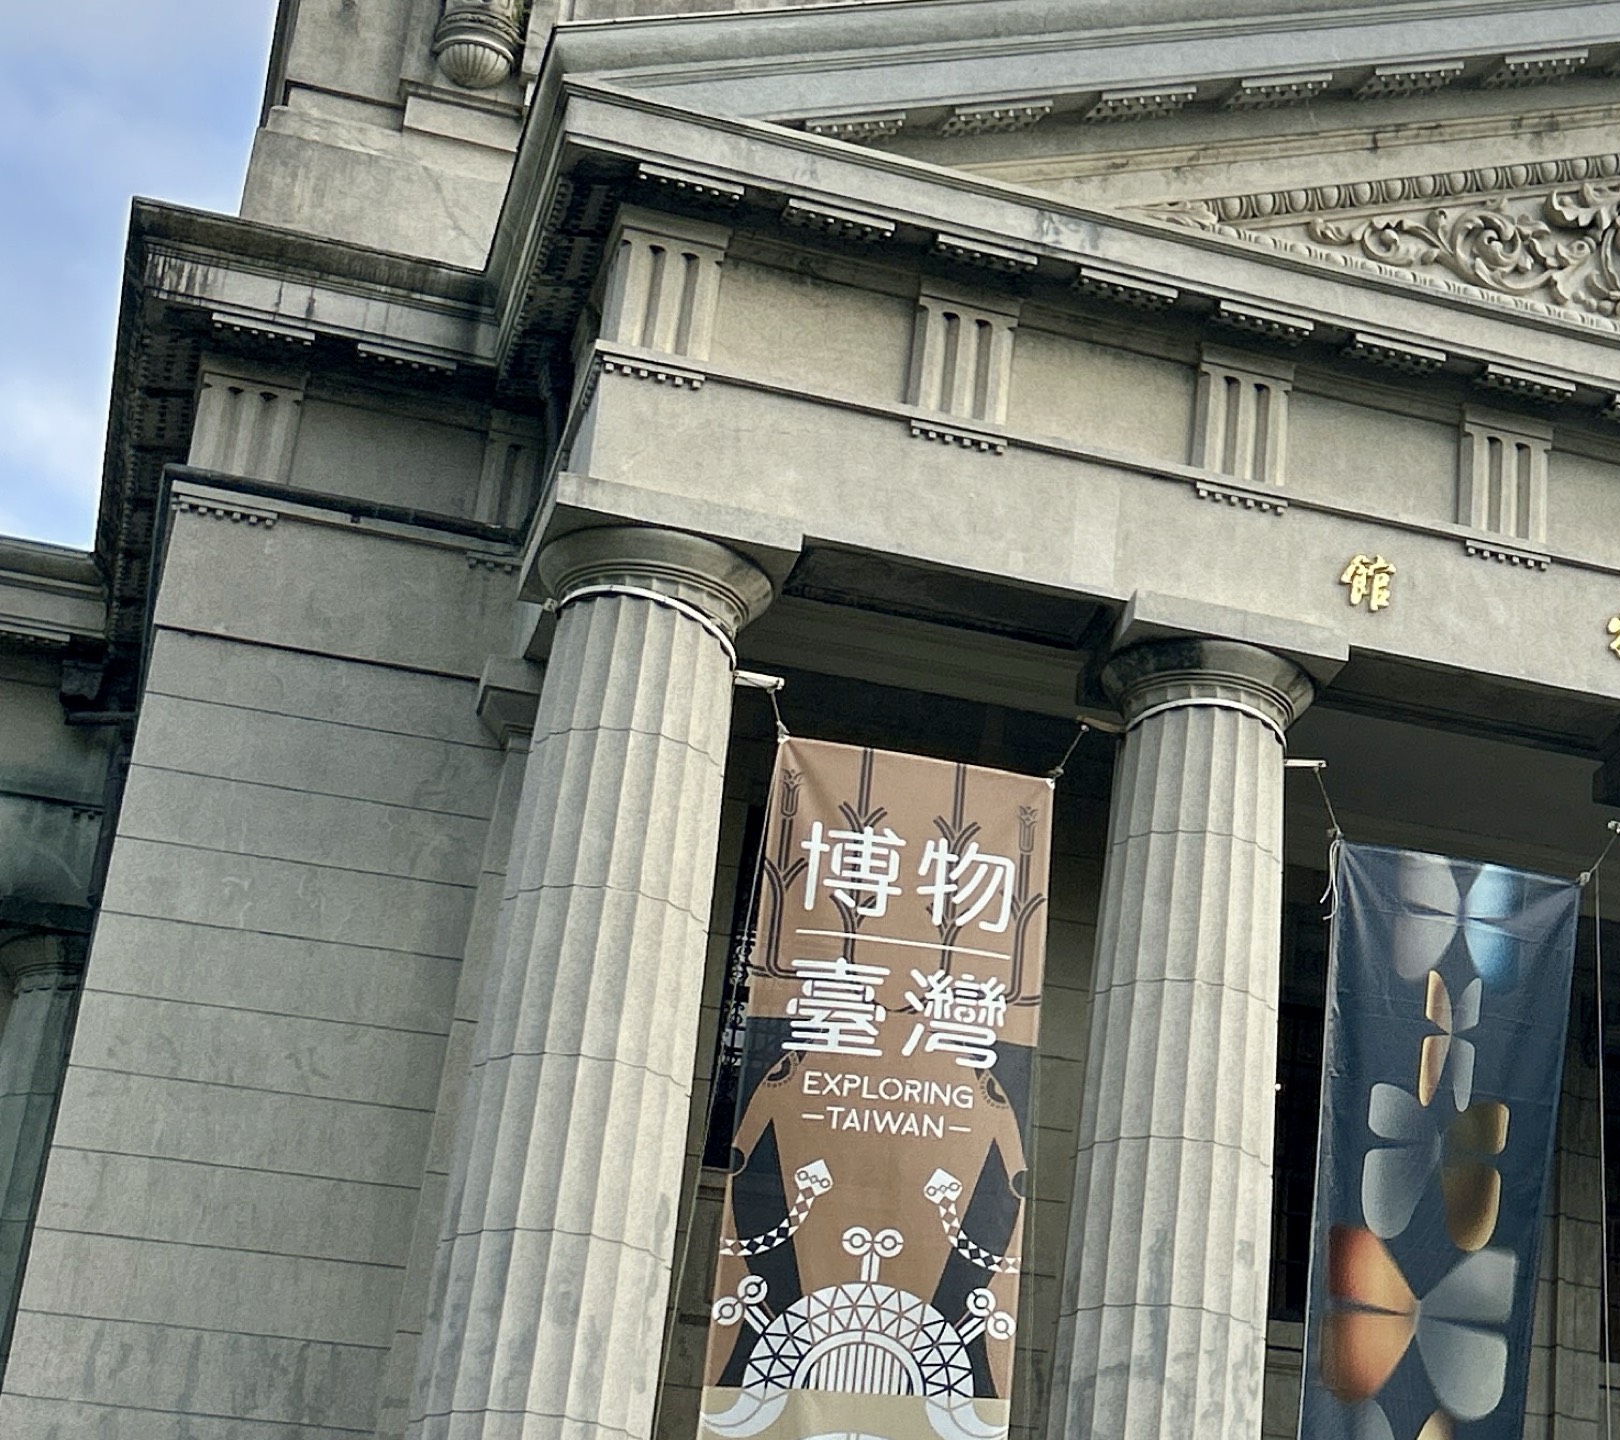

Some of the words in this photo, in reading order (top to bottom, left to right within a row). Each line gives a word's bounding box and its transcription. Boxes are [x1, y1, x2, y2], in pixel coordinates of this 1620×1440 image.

[801, 821, 1016, 933] 博物
[781, 957, 1007, 1069] 臺灣
[802, 1071, 974, 1109] EXPLORING
[826, 1106, 945, 1139] TAIWAN
